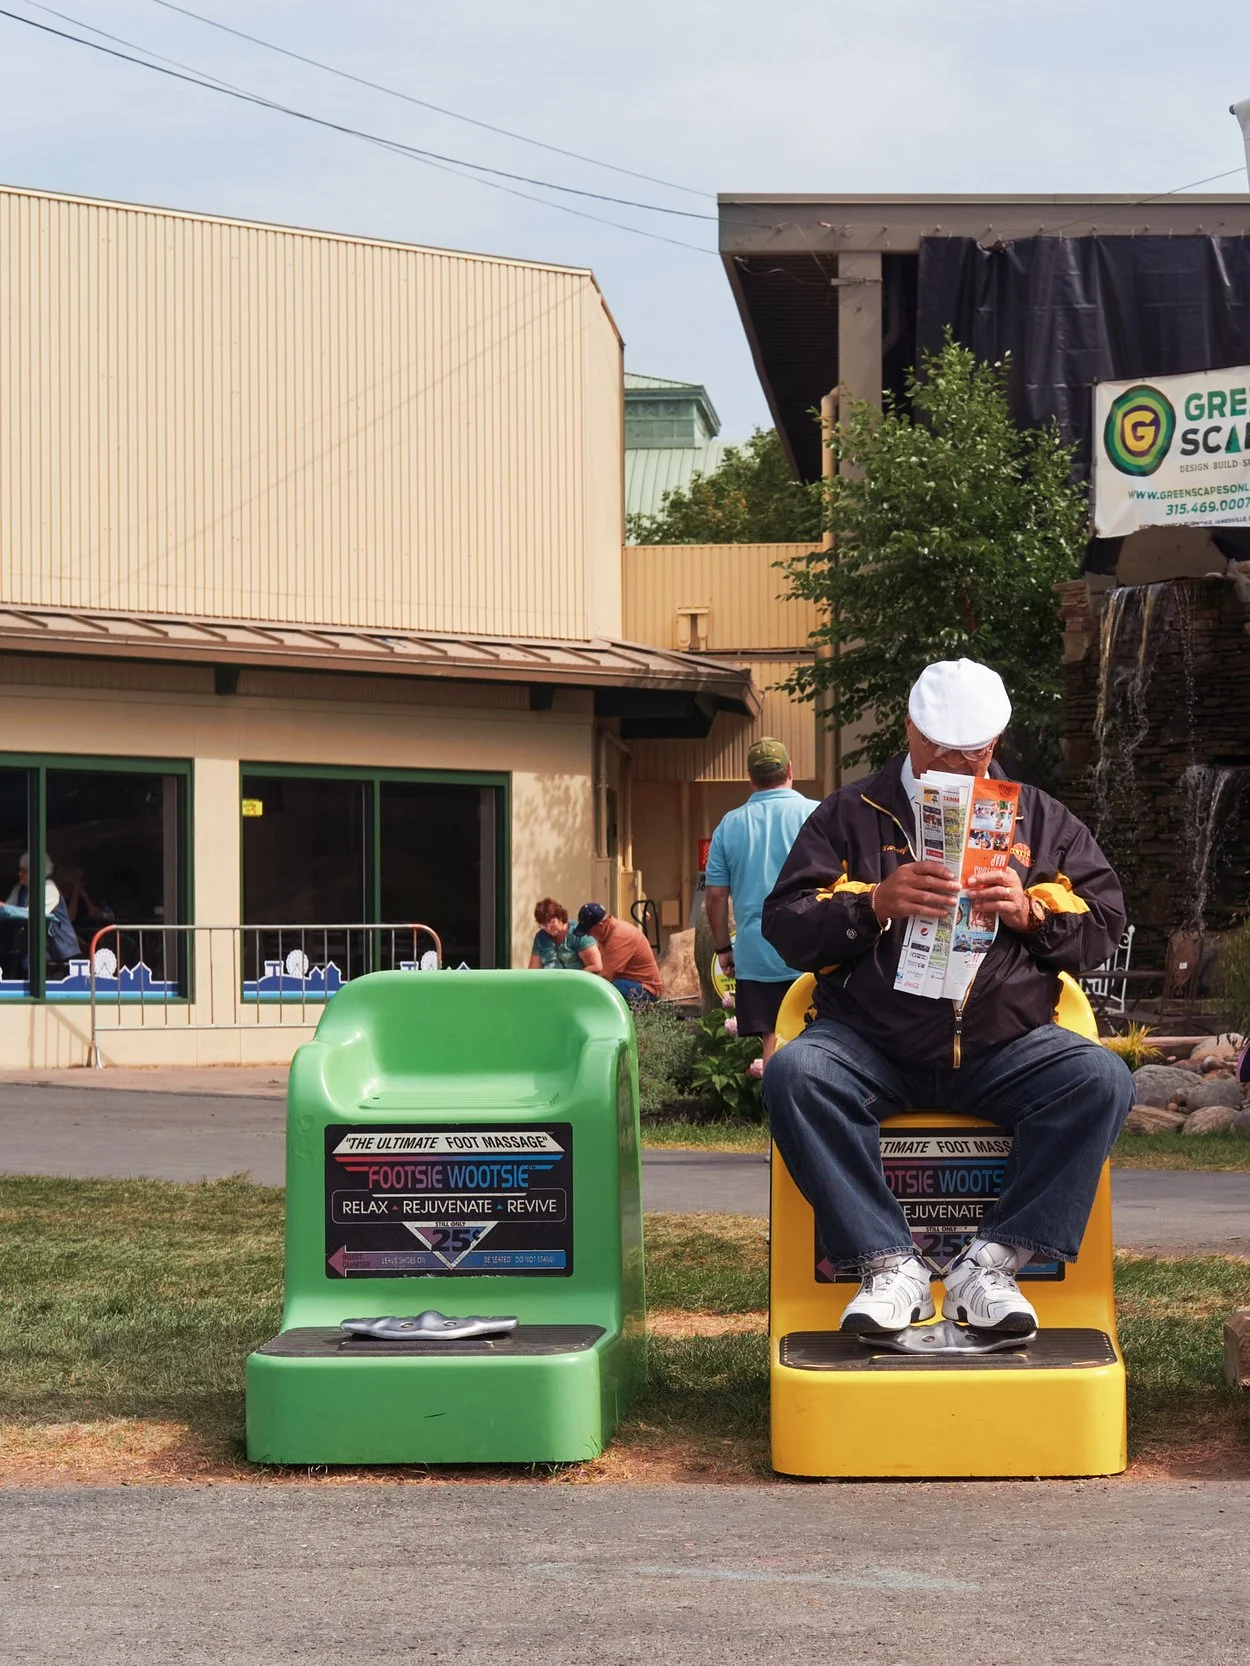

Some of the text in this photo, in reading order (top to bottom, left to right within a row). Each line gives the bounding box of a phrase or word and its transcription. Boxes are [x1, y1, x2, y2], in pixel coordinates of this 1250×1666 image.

[1180, 463, 1209, 473] DESIGN
[1213, 460, 1238, 470] BUILD
[376, 1137, 439, 1149] ULTIMATE
[445, 1136, 480, 1149] FOOT
[881, 1139, 1012, 1153] TIMATE FOOT MASS
[368, 1164, 529, 1189] FOOTSIE WOOTSIE
[885, 1169, 1004, 1193] OTSIE WOOTS
[342, 1199, 557, 1214] RELAX REJUVENATE REVIVE
[903, 1205, 984, 1218] EJUVENATE
[381, 1257, 398, 1265] LEAVE
